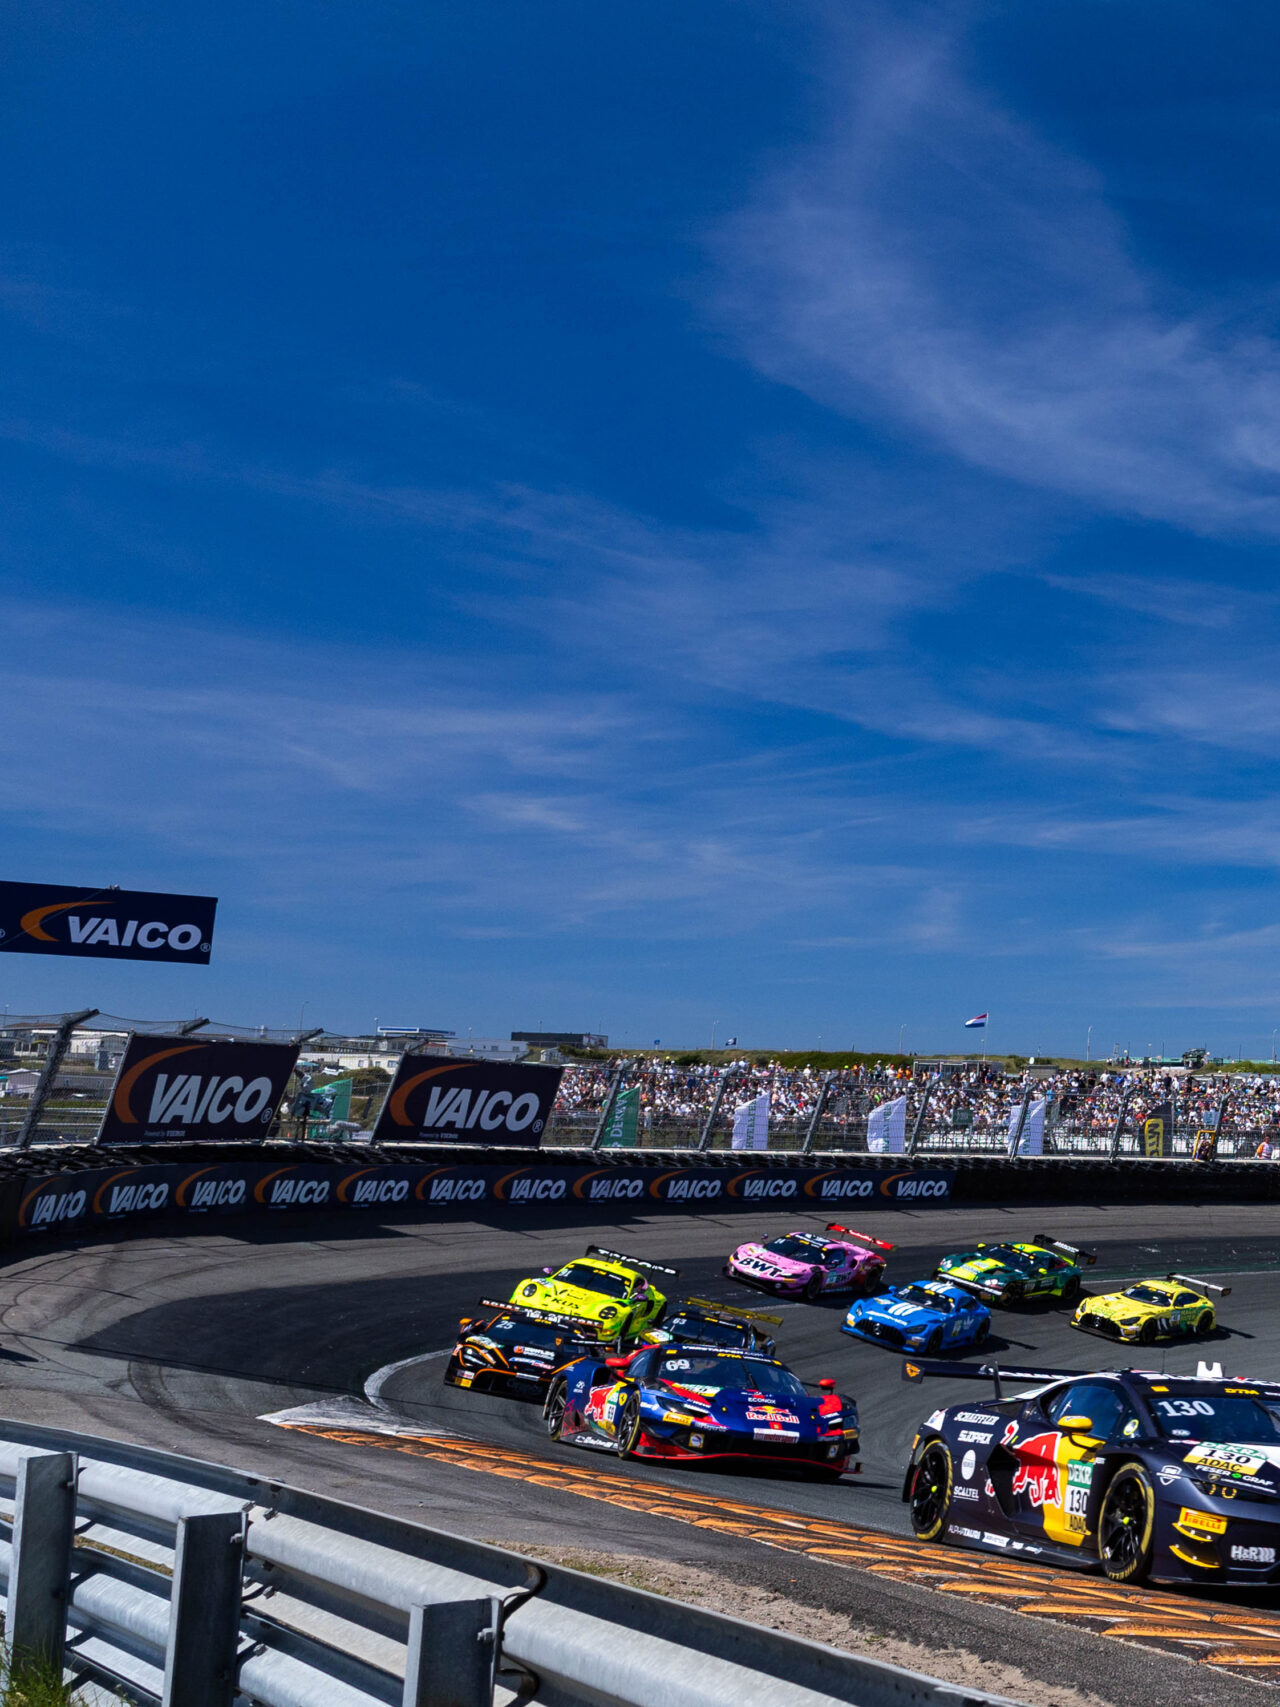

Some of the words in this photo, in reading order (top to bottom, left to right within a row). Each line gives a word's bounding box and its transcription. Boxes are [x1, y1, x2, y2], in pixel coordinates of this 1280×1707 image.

[68, 915, 202, 951] VAICO
[149, 1073, 272, 1124] VAICO
[423, 1086, 540, 1132] VAICO
[191, 1180, 246, 1206] VAICO
[270, 1180, 330, 1203] VAICO
[354, 1180, 409, 1202] VAICO
[430, 1179, 485, 1200] VAICO
[509, 1179, 566, 1200] VAICO
[589, 1179, 644, 1198] VAICO
[666, 1179, 721, 1198] VAICO
[743, 1179, 797, 1197] VAICO
[821, 1180, 873, 1197] VAICO
[896, 1180, 948, 1197] VAICO
[31, 1190, 87, 1225] VAICO
[109, 1183, 169, 1213] VAICO
[738, 1257, 783, 1278] BWT
[495, 1320, 516, 1330] 25
[665, 1358, 690, 1371] 69
[746, 1411, 774, 1420] Red
[774, 1412, 800, 1424] Bull
[1158, 1400, 1216, 1417] 130
[954, 1411, 1000, 1426] SCHAEFFLER
[1200, 1442, 1268, 1460] DEKRA
[1204, 1450, 1251, 1464] 130
[1067, 1462, 1093, 1484] DEKR
[1198, 1457, 1243, 1472] ADAC
[1195, 1464, 1232, 1476] FESER
[1242, 1475, 1274, 1487] GRAF
[953, 1486, 979, 1498] SCALTEL
[1069, 1489, 1089, 1514] 130
[1184, 1511, 1222, 1530] PIRELLI
[1230, 1545, 1260, 1563] H&R
